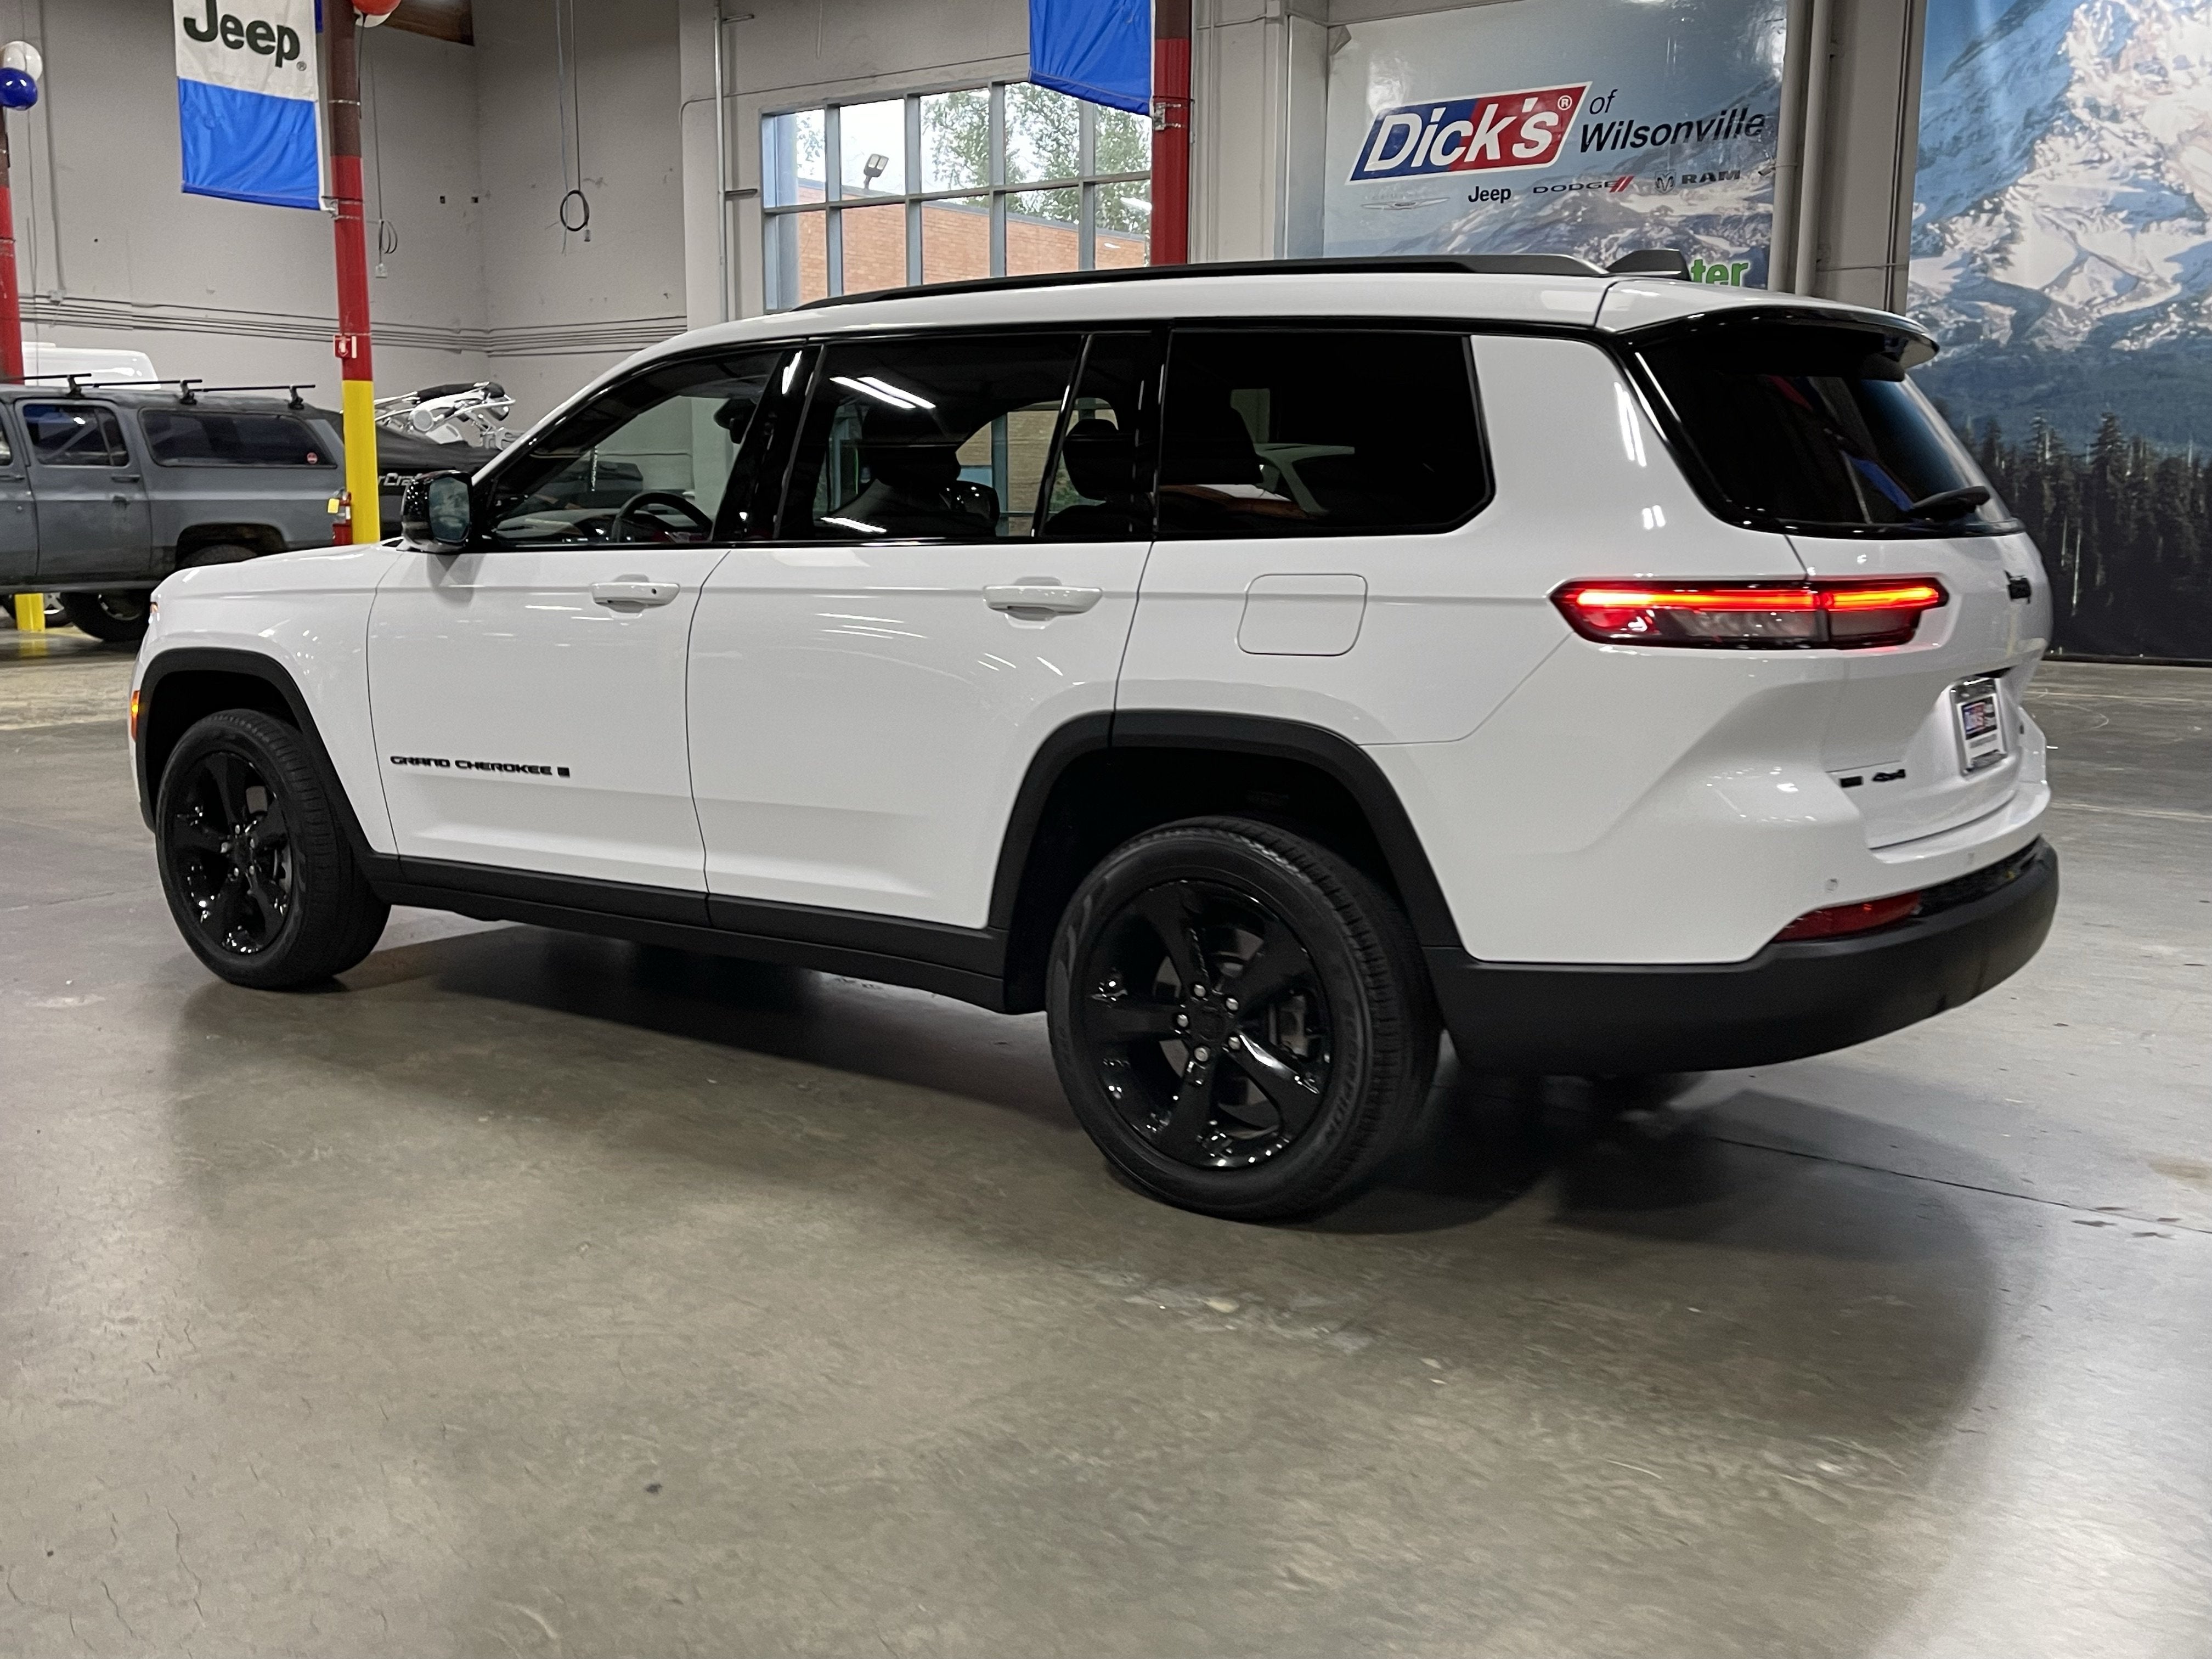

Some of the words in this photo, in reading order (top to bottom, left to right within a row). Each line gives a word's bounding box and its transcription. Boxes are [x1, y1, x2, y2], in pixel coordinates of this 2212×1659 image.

[184, 0, 301, 67] Jeep
[1589, 89, 1618, 115] of
[1580, 107, 1765, 153] Wilsonville
[1468, 186, 1511, 204] Jeep
[1533, 180, 1618, 194] DODGE
[1681, 170, 1741, 184] RAM
[1691, 259, 1749, 286] ter
[390, 756, 450, 768] GRAND
[455, 760, 552, 776] CHEROKEE
